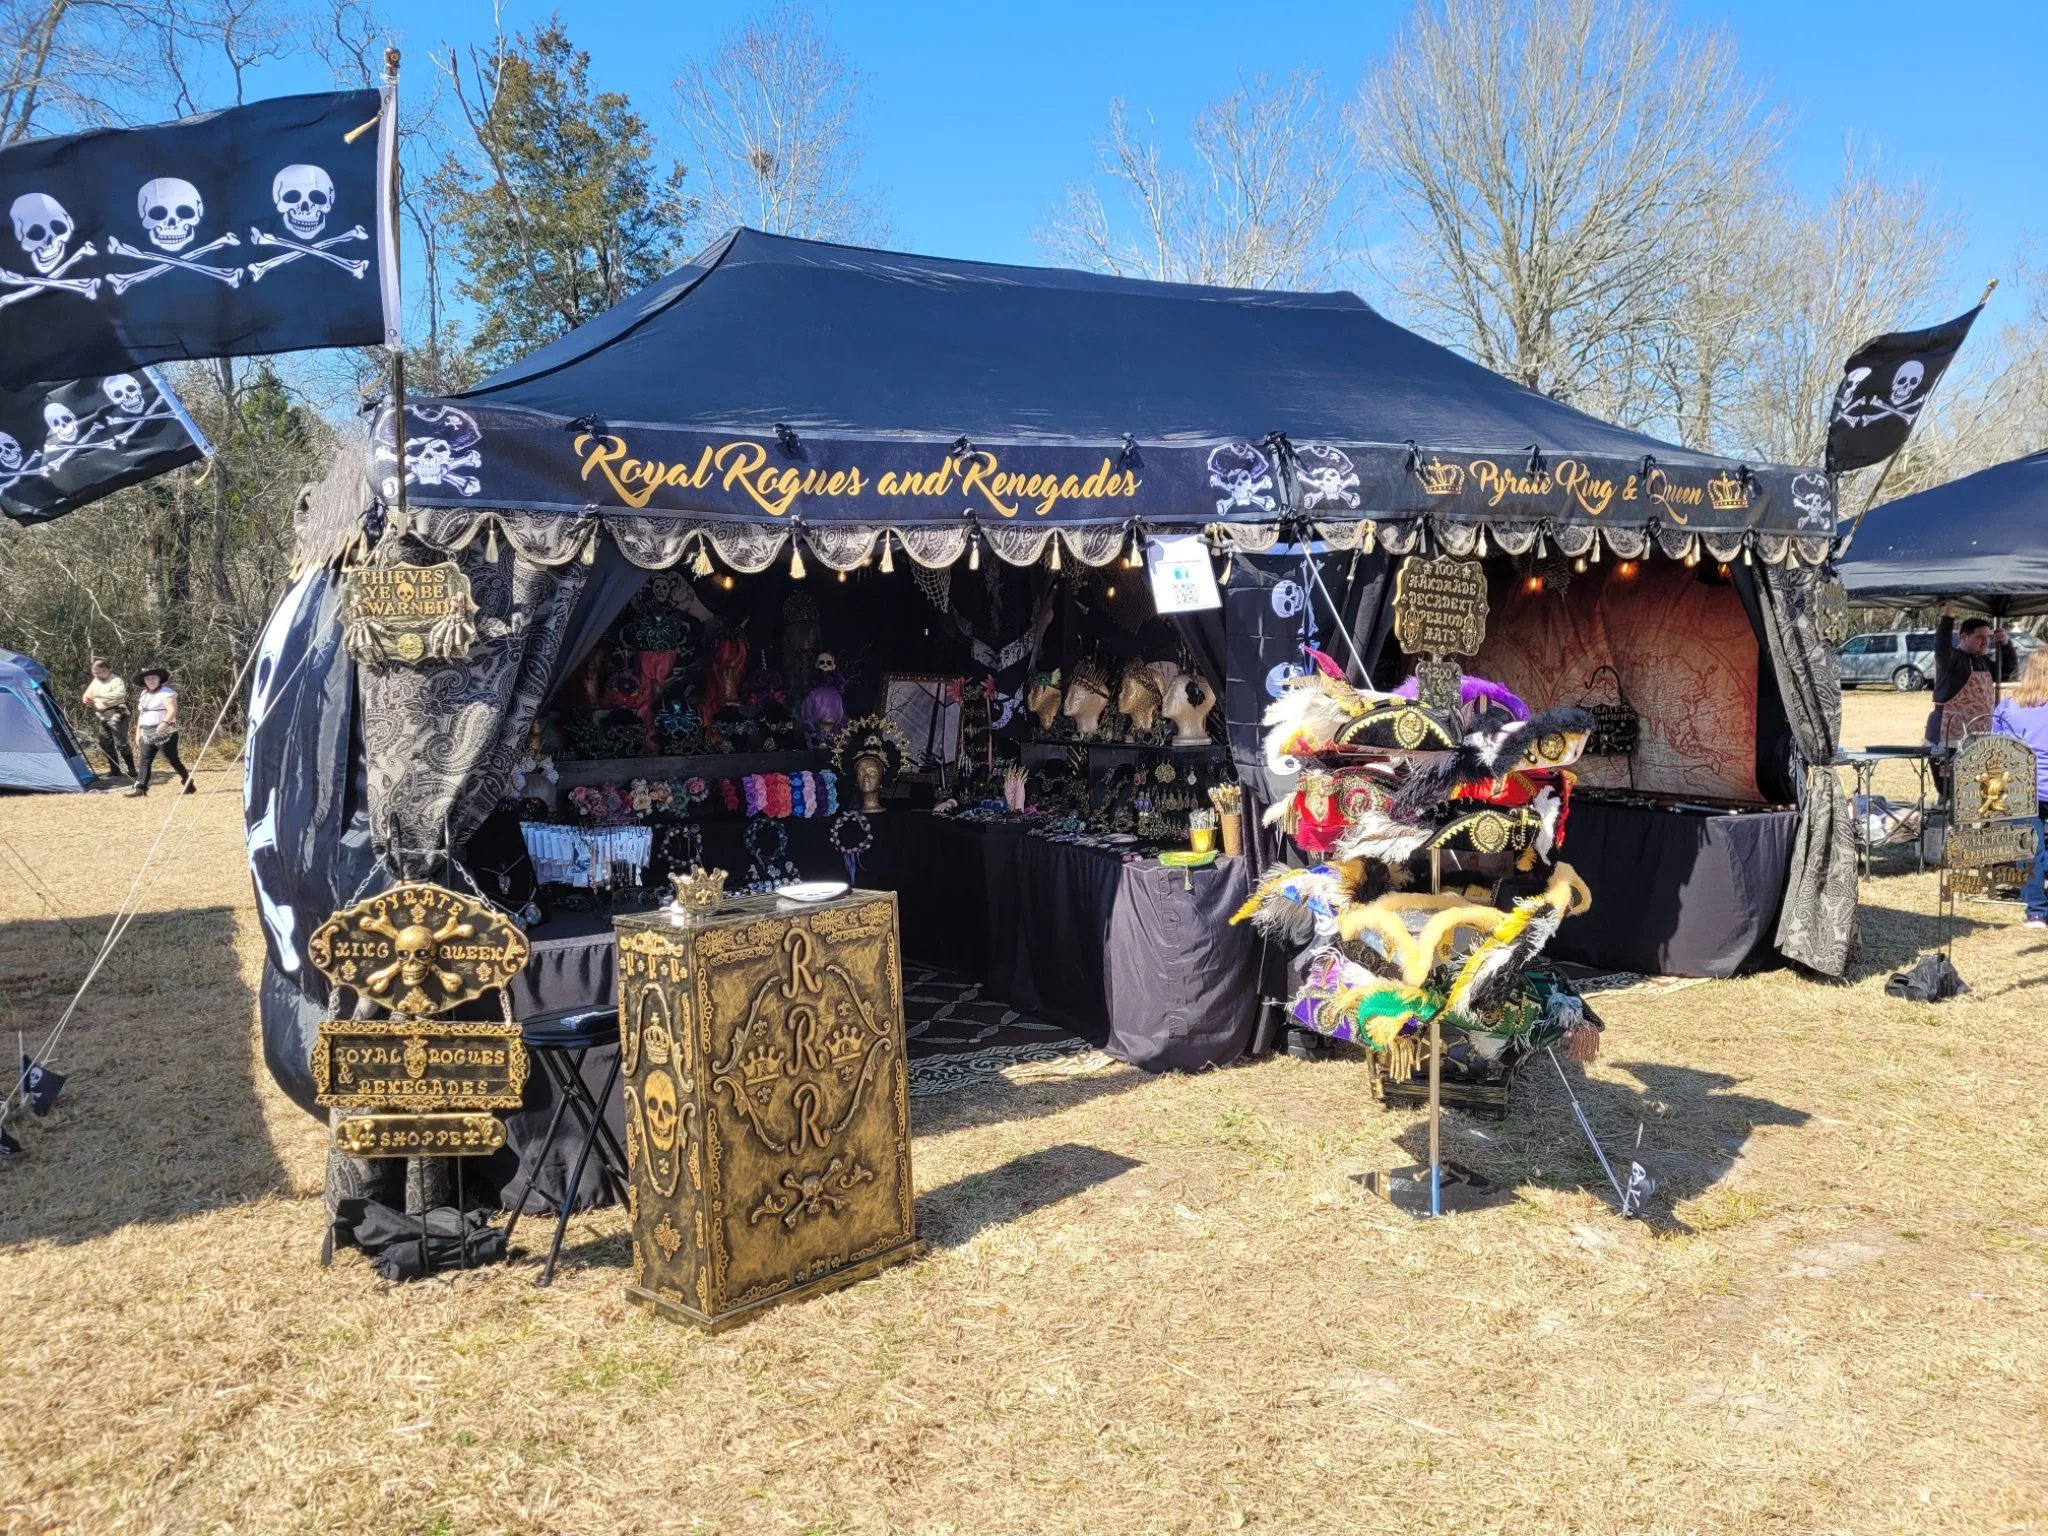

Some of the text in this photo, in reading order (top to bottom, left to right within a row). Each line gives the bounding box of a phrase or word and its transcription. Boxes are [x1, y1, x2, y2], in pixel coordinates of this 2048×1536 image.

[573, 434, 1143, 518] Royal Rogues and Renegades
[1469, 460, 1705, 525] Pyrate King & Queen
[357, 569, 446, 584] THIEVES
[1408, 574, 1477, 595] HANDMADE
[366, 585, 445, 599] YE BE
[1408, 591, 1475, 612] DECADENT
[368, 600, 450, 616] WARNED
[1418, 610, 1465, 629] PERIOD
[1423, 626, 1458, 643] HATS
[375, 889, 464, 918] PYRATE
[334, 941, 504, 960] KING QUEEN
[782, 928, 822, 998] R
[785, 1006, 827, 1076] R
[333, 1047, 506, 1066] ROYAL ROGUES
[756, 1062, 770, 1078] K
[337, 1065, 489, 1096] & RENEGADES
[790, 1083, 831, 1155] R
[379, 1130, 462, 1147] SHOPPE
